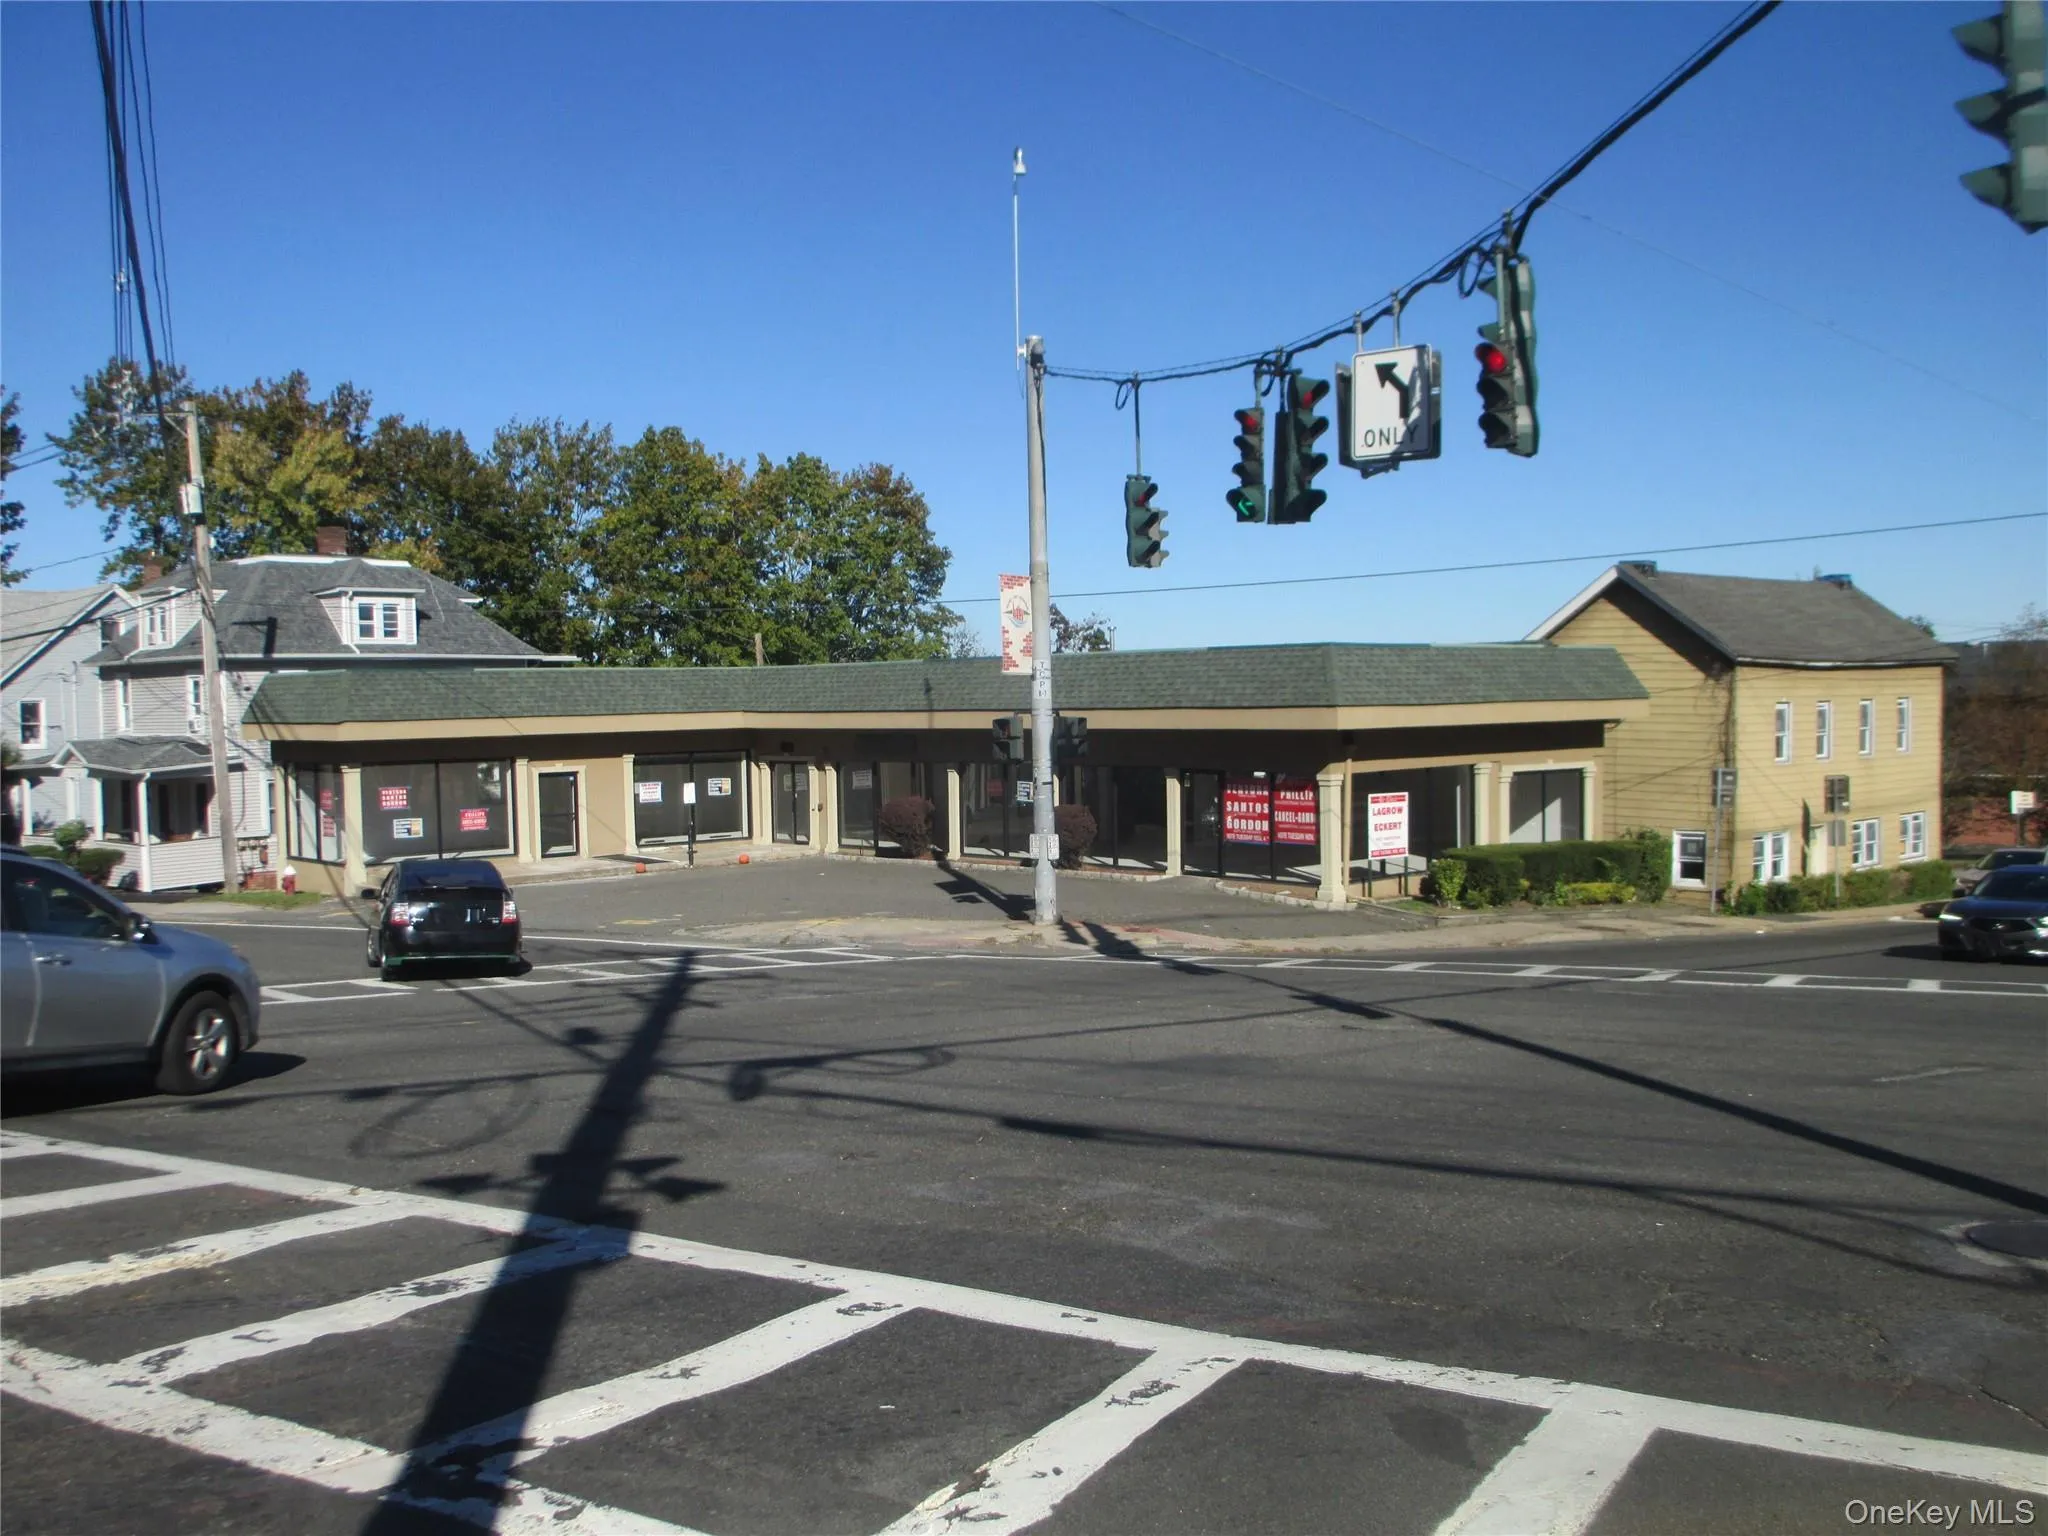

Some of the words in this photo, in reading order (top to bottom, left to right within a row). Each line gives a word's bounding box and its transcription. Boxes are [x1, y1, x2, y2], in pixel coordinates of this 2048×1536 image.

[1364, 425, 1418, 448] ONLY
[1280, 790, 1314, 800] PHILLIP
[1226, 801, 1269, 814] SANTOS
[1372, 806, 1404, 817] LAGROW
[1226, 818, 1269, 831] GORDON
[1374, 822, 1402, 832] ECKERT
